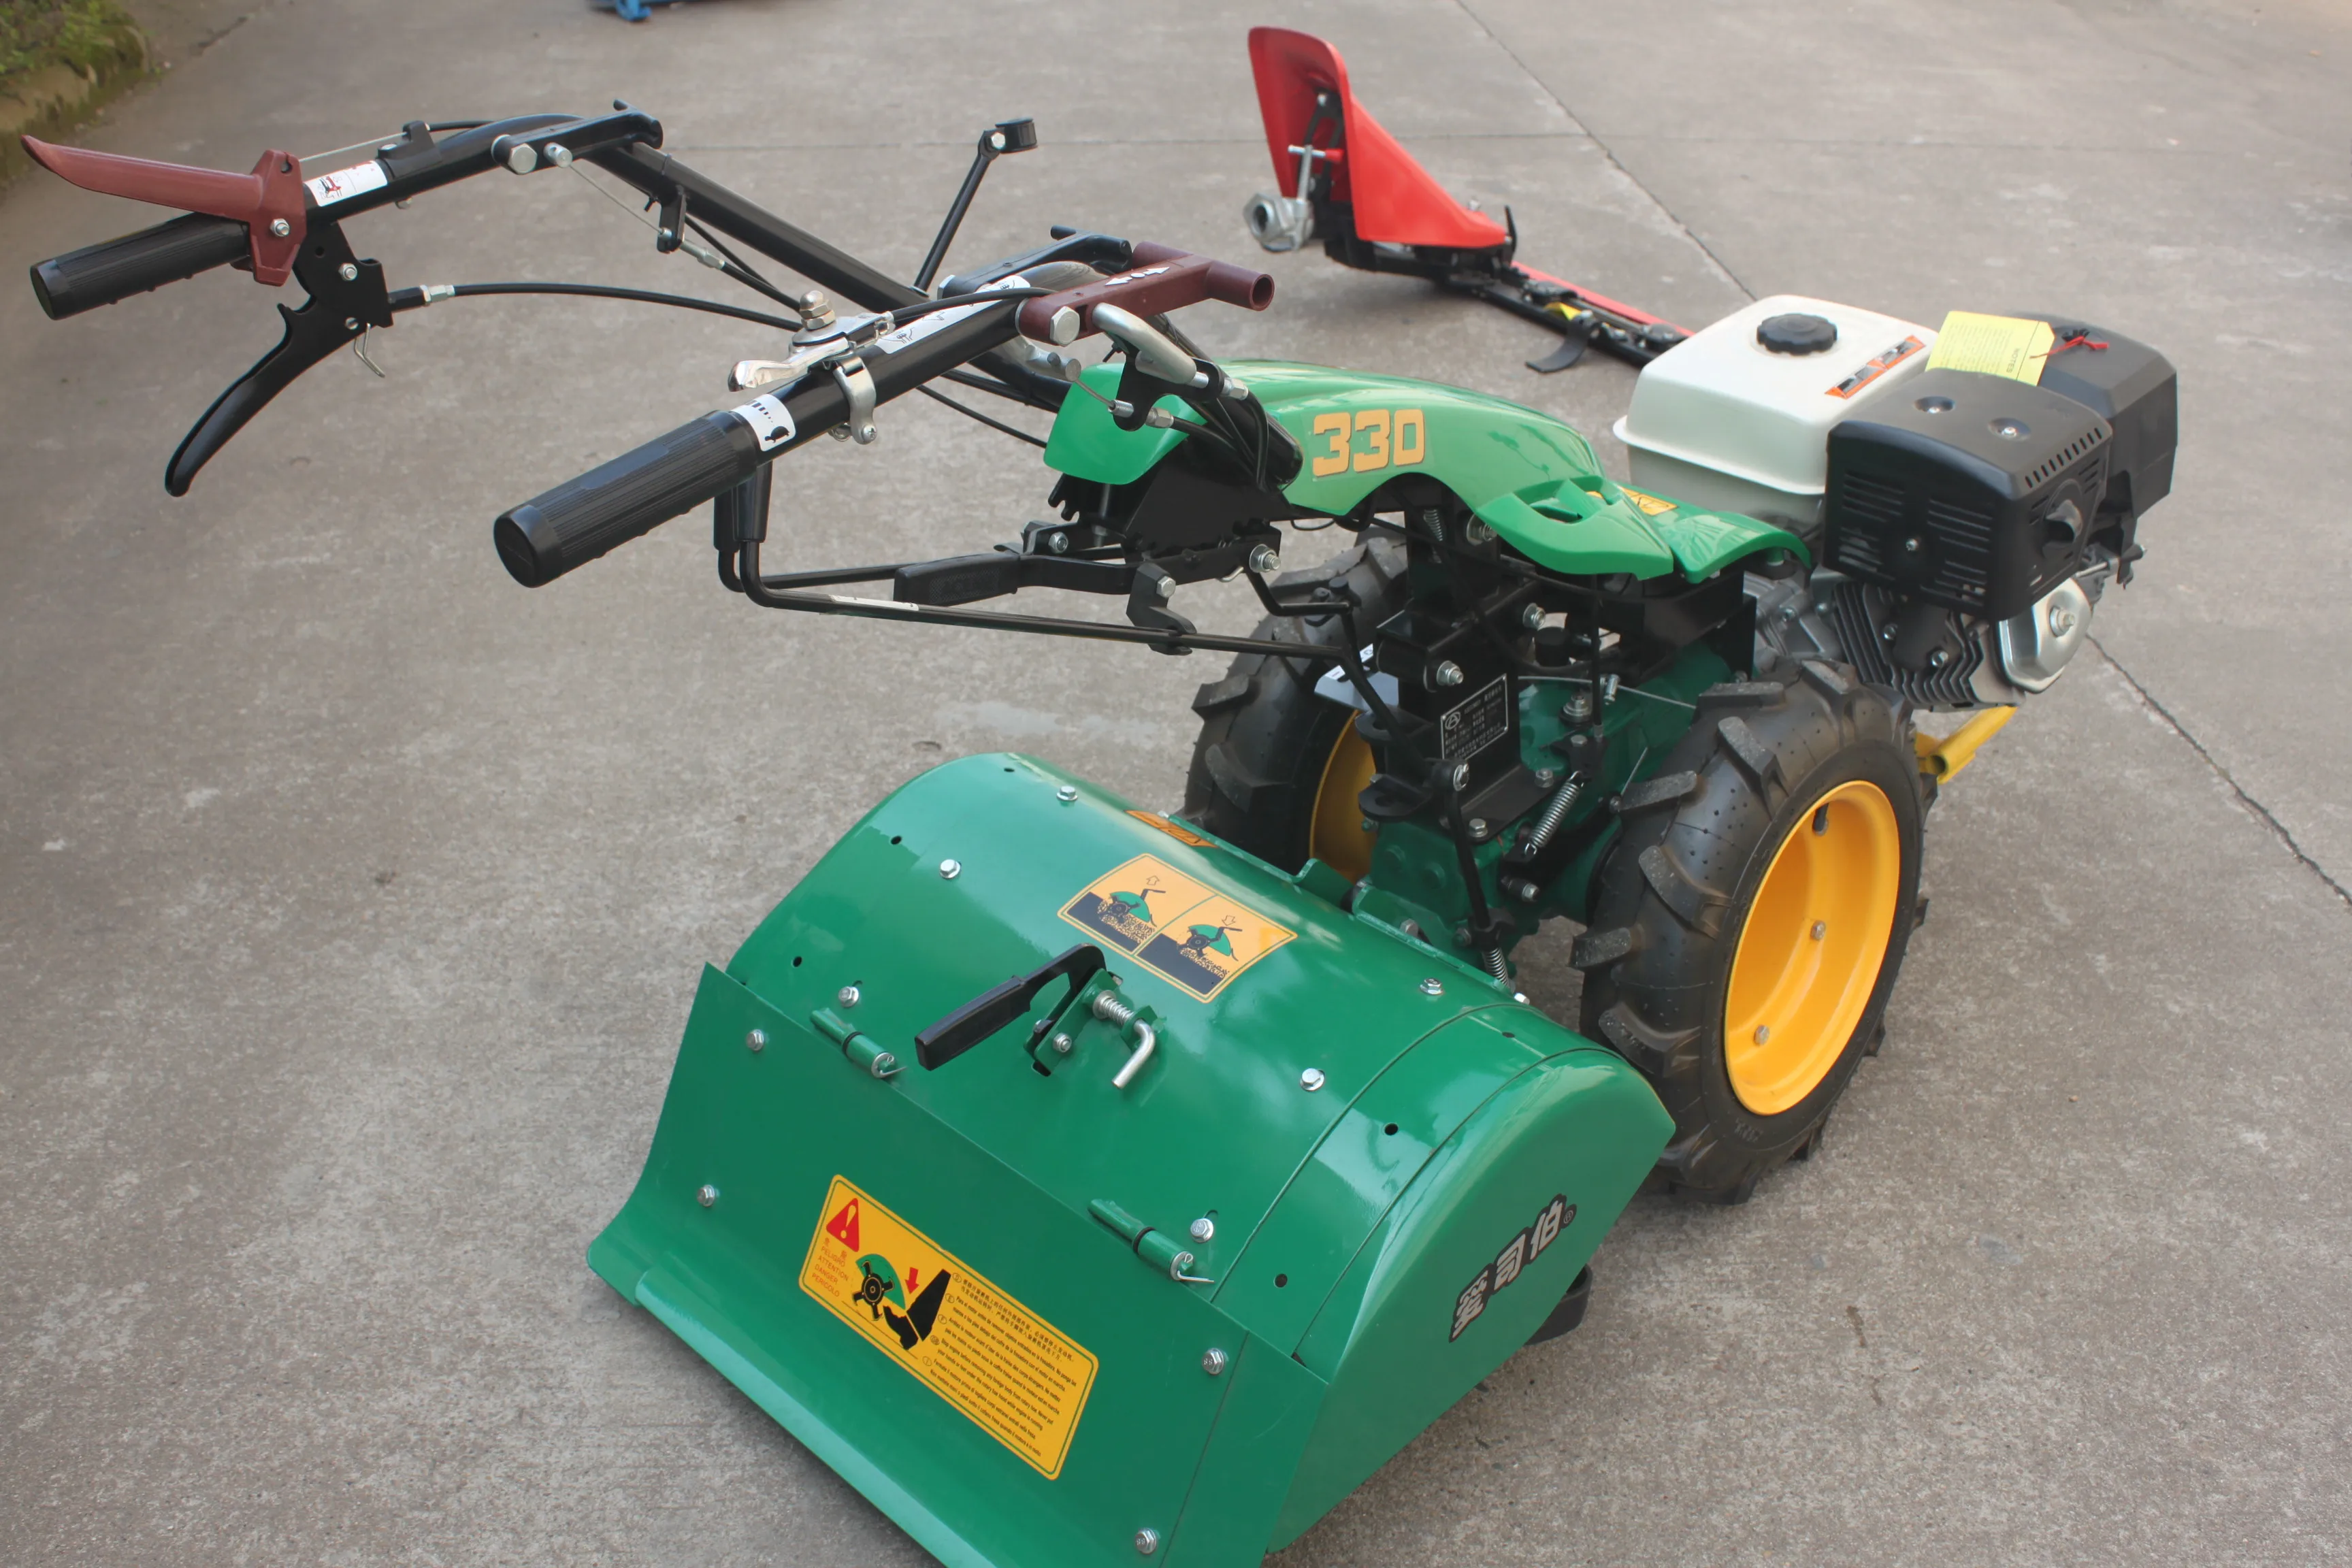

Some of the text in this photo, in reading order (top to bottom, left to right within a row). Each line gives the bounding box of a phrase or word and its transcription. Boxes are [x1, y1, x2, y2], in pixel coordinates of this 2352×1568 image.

[1312, 409, 1425, 478] 330
[817, 1255, 849, 1281] ATTENTION
[821, 1246, 845, 1267] PELIGRO
[812, 1273, 840, 1296] PERICOLO
[815, 1264, 838, 1285] DANGER
